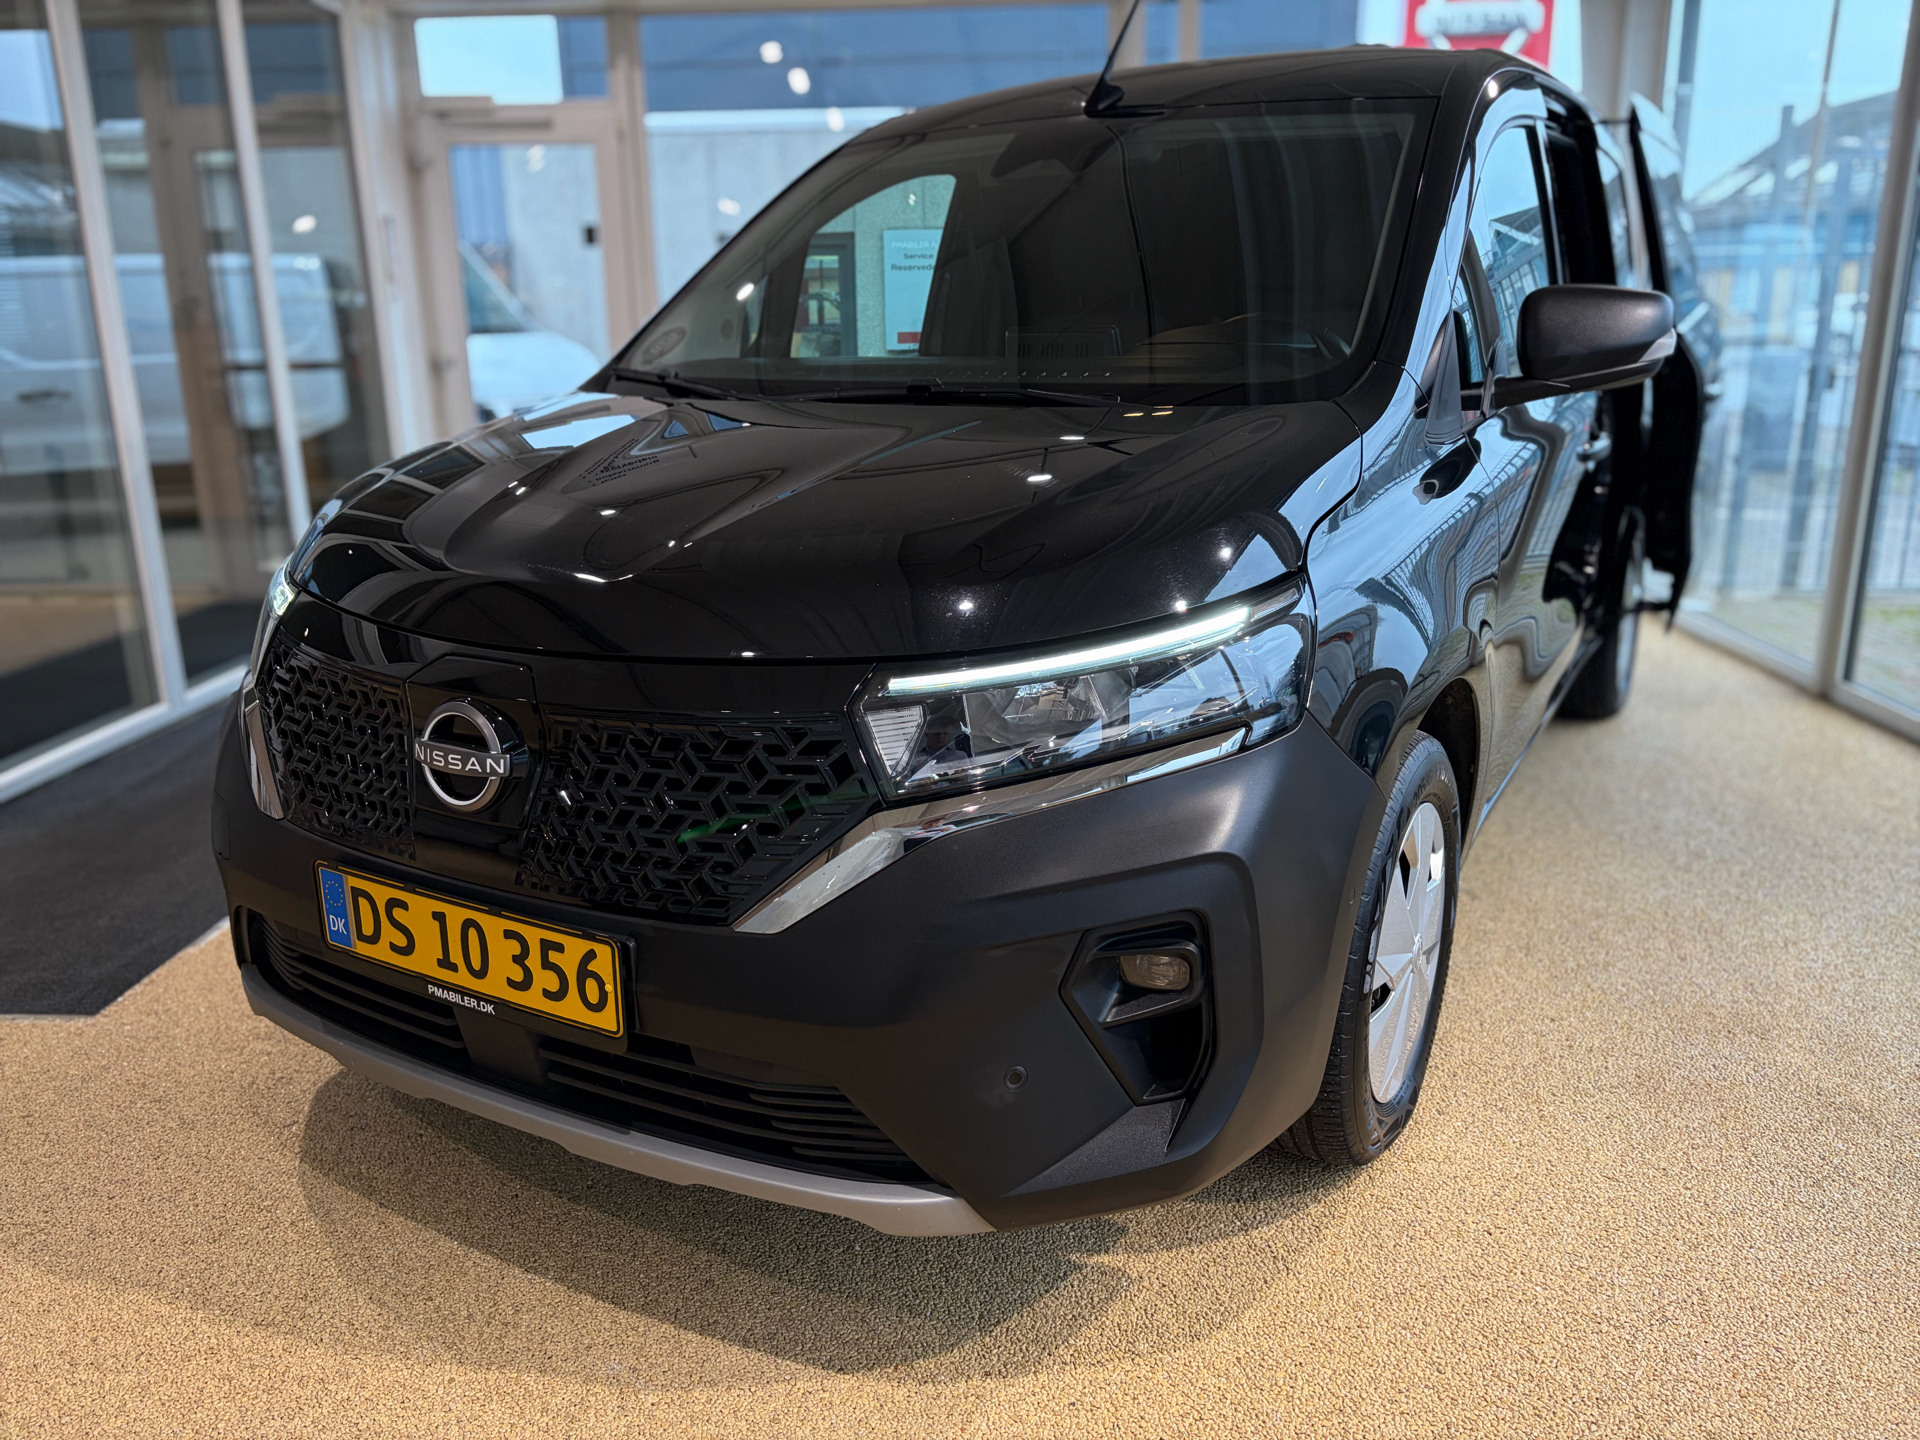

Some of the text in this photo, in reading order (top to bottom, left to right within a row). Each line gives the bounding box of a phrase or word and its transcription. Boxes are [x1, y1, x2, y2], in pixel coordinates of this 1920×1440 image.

[903, 252, 934, 260] Service
[415, 742, 505, 774] NISSAN
[329, 914, 347, 935] DK
[350, 885, 610, 1013] DS 10 356
[428, 984, 496, 1015] PMABILER.DK
